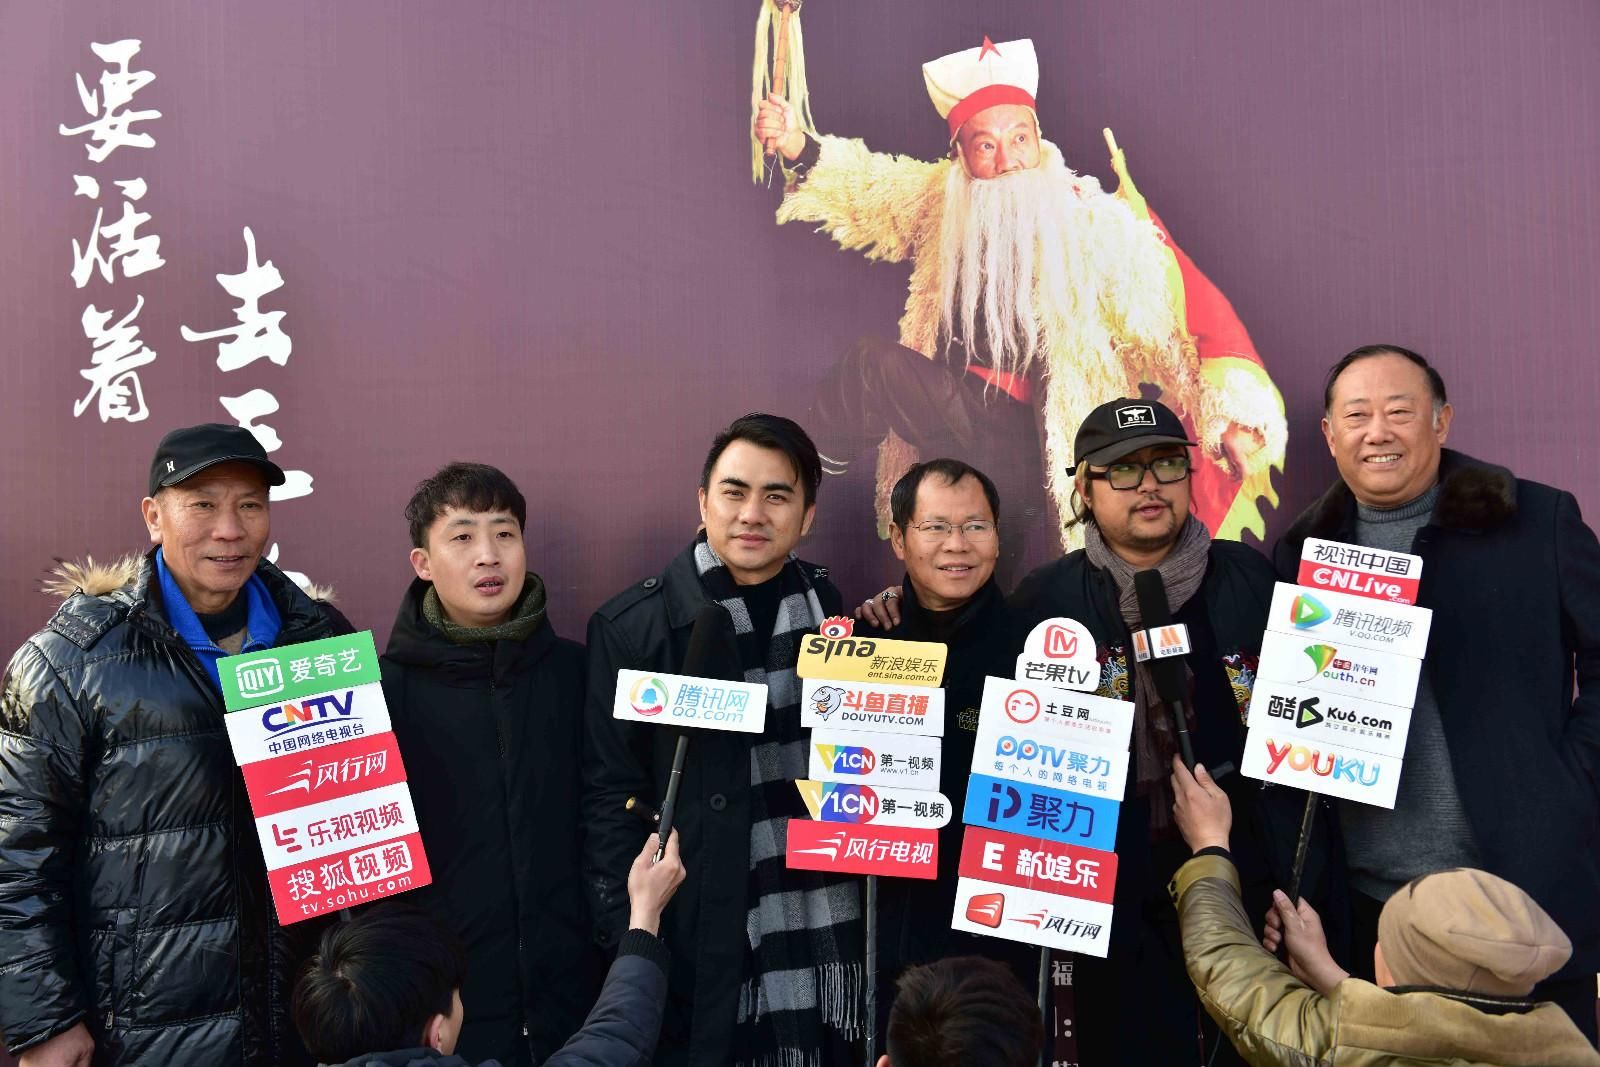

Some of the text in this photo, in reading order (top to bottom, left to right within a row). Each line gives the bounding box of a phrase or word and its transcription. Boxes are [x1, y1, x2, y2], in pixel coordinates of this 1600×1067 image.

[1313, 544, 1411, 575] 视讯中国
[1333, 608, 1413, 638] 腾讯视频
[1349, 630, 1394, 643] V.QQ.COM
[806, 637, 876, 664] sina
[869, 654, 938, 674] 新浪娱乐
[289, 647, 363, 684] 爱奇艺
[867, 670, 938, 682] ent.sina.com.cn
[262, 690, 354, 733] CNTV
[674, 684, 749, 712] 腾讯网
[842, 690, 930, 717] 斗鱼直播
[1045, 702, 1090, 720] 土豆网
[672, 706, 744, 723] QQ.com
[841, 712, 924, 726] DOUYUTV.COM
[1327, 707, 1392, 730] Ku6.com
[268, 723, 365, 755] 中国网络电视台
[313, 750, 388, 790] 风行网
[880, 753, 934, 771] 第一视频
[880, 766, 919, 776] www.v1.cn
[993, 760, 1108, 791] 每个人的网络电视
[1066, 751, 1111, 777] 聚力
[881, 798, 945, 819] 第一视频
[1026, 793, 1095, 838] 聚力
[307, 801, 405, 847] 乐视视频
[843, 837, 934, 865] 风行电视
[981, 841, 1100, 889] E 新娱乐
[300, 875, 412, 916] tv.sohu.com
[1043, 915, 1102, 940] 风行网
